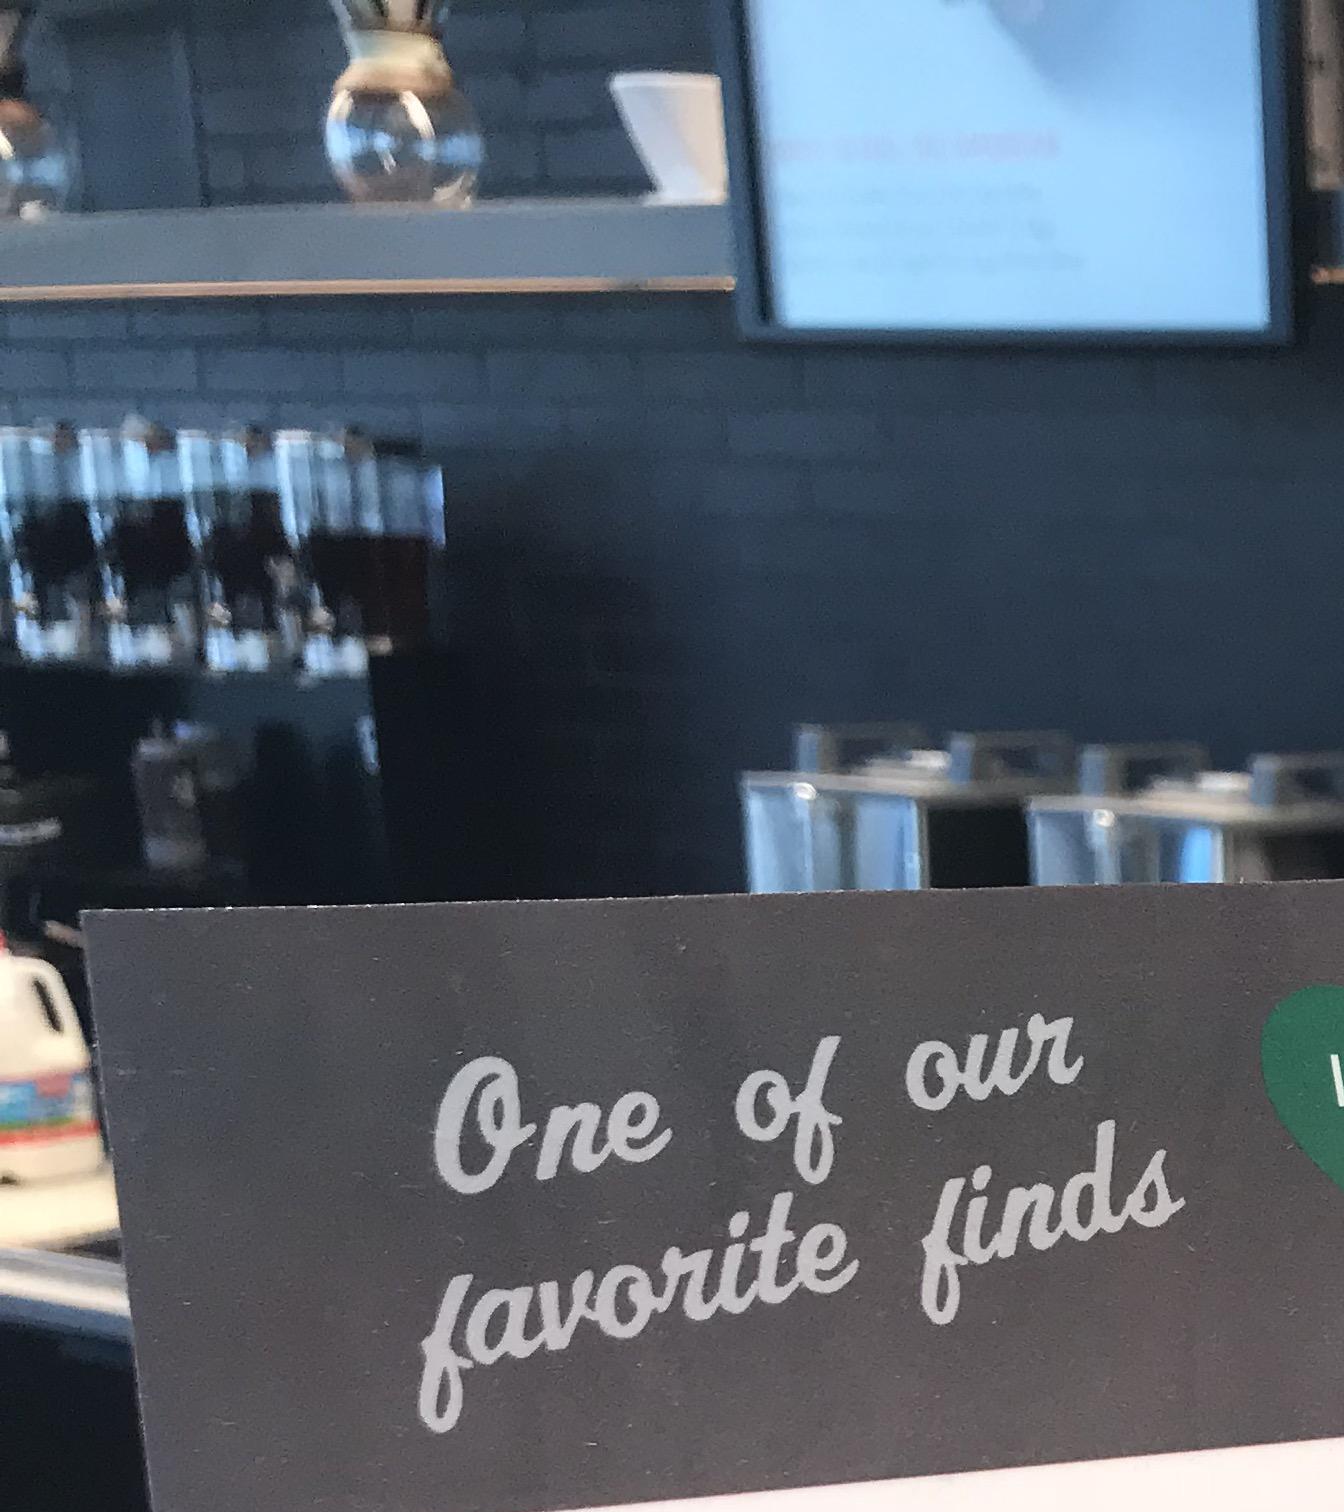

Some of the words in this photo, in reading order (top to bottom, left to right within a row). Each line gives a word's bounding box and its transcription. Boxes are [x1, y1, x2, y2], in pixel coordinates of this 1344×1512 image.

[434, 1055, 673, 1195] One
[734, 1035, 843, 1185] of
[906, 1013, 1083, 1112] our
[420, 1192, 860, 1434] favorite
[921, 1120, 1186, 1326] finds
